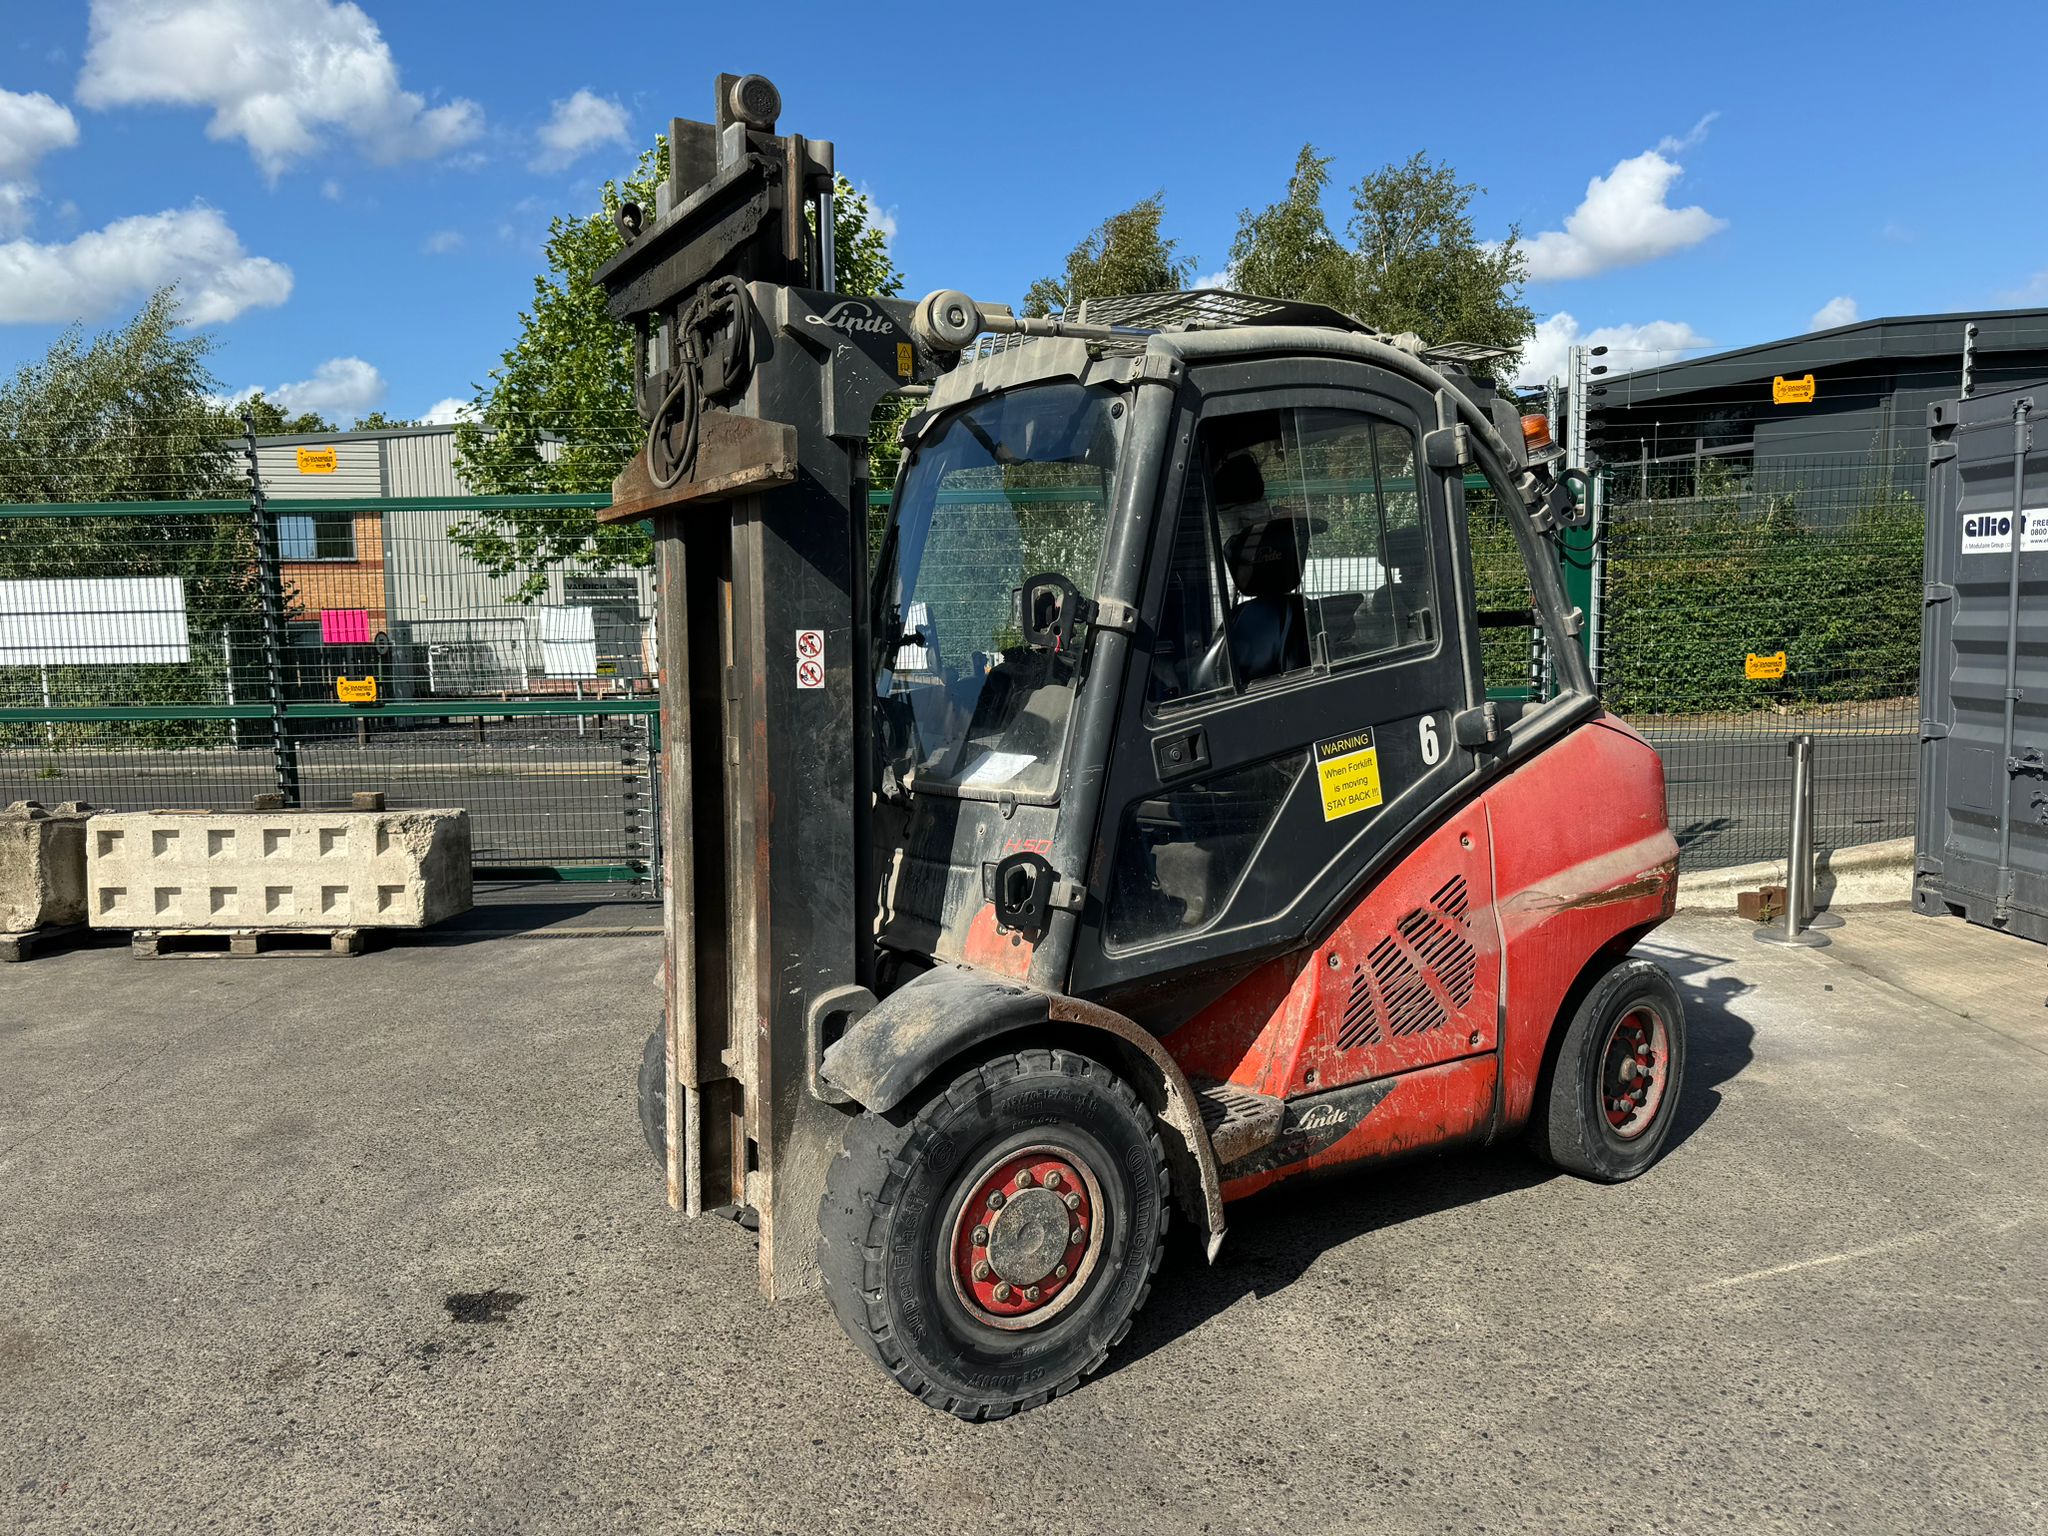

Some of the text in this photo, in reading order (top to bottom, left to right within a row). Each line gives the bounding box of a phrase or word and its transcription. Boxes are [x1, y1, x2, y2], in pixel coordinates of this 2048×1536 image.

[805, 301, 894, 335] Linde
[1965, 515, 2027, 537] elliot
[1321, 733, 1369, 756] WARNING
[1418, 715, 1440, 766] 6
[1324, 757, 1373, 779] When Forklift
[1334, 776, 1369, 792] is moving
[1326, 796, 1348, 811] STAY
[1348, 790, 1371, 805] BACK
[1283, 1104, 1348, 1135] Linde
[1110, 1144, 1155, 1304] Continental
[893, 1183, 931, 1342] Super Elastic
